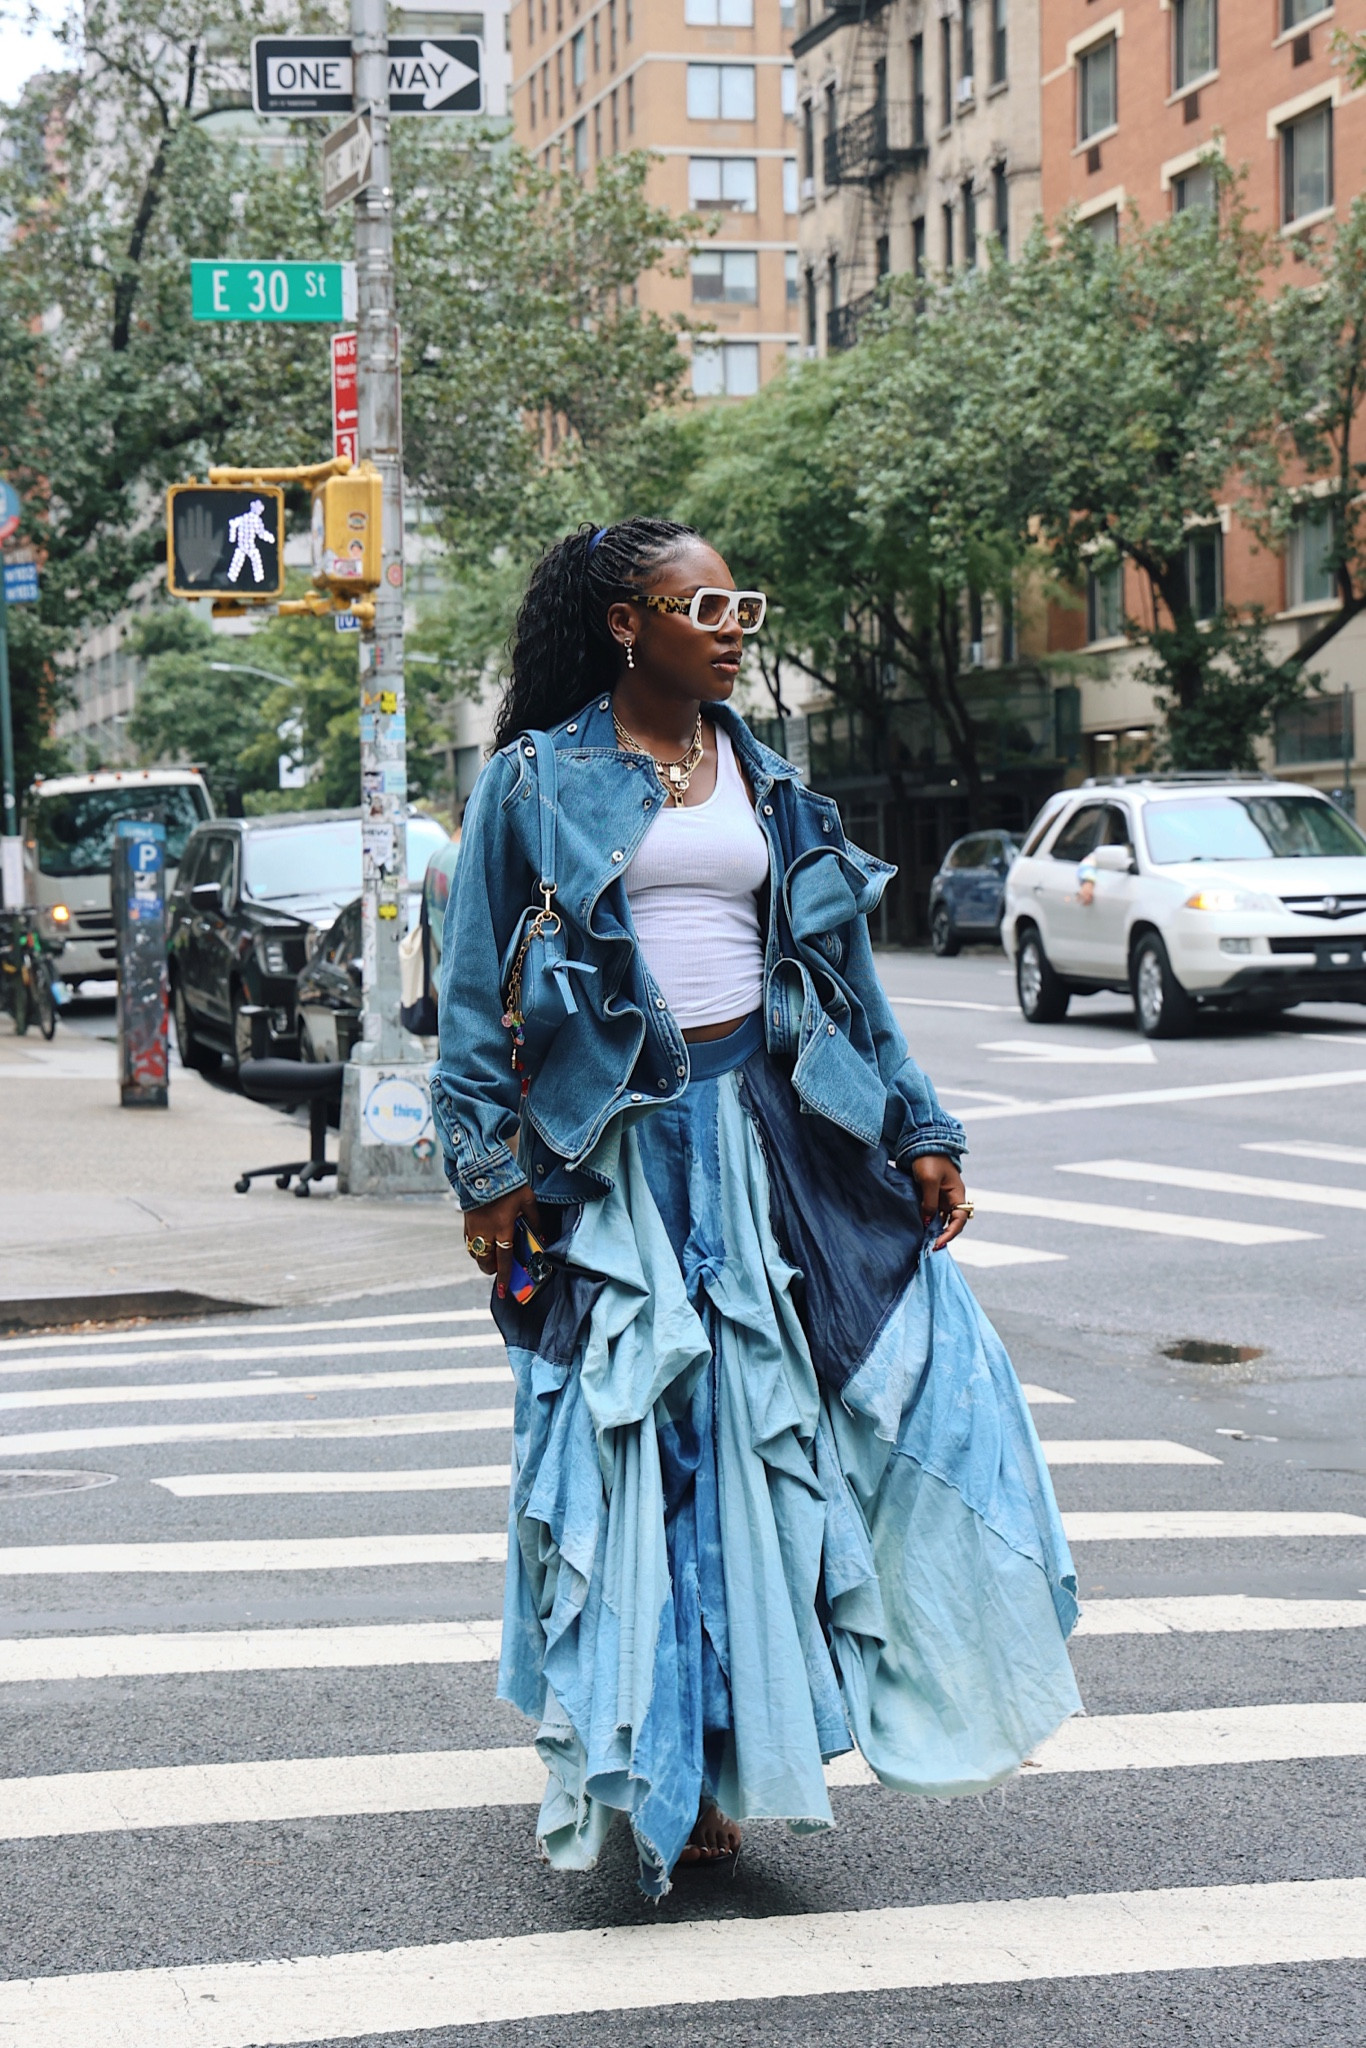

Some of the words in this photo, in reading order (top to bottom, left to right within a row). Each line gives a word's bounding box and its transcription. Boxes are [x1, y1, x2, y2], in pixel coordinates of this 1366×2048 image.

[277, 63, 341, 89] ONE
[388, 63, 449, 89] WAY
[212, 269, 230, 313] E
[247, 269, 290, 313] 30
[304, 270, 327, 298] St
[139, 844, 157, 870] P
